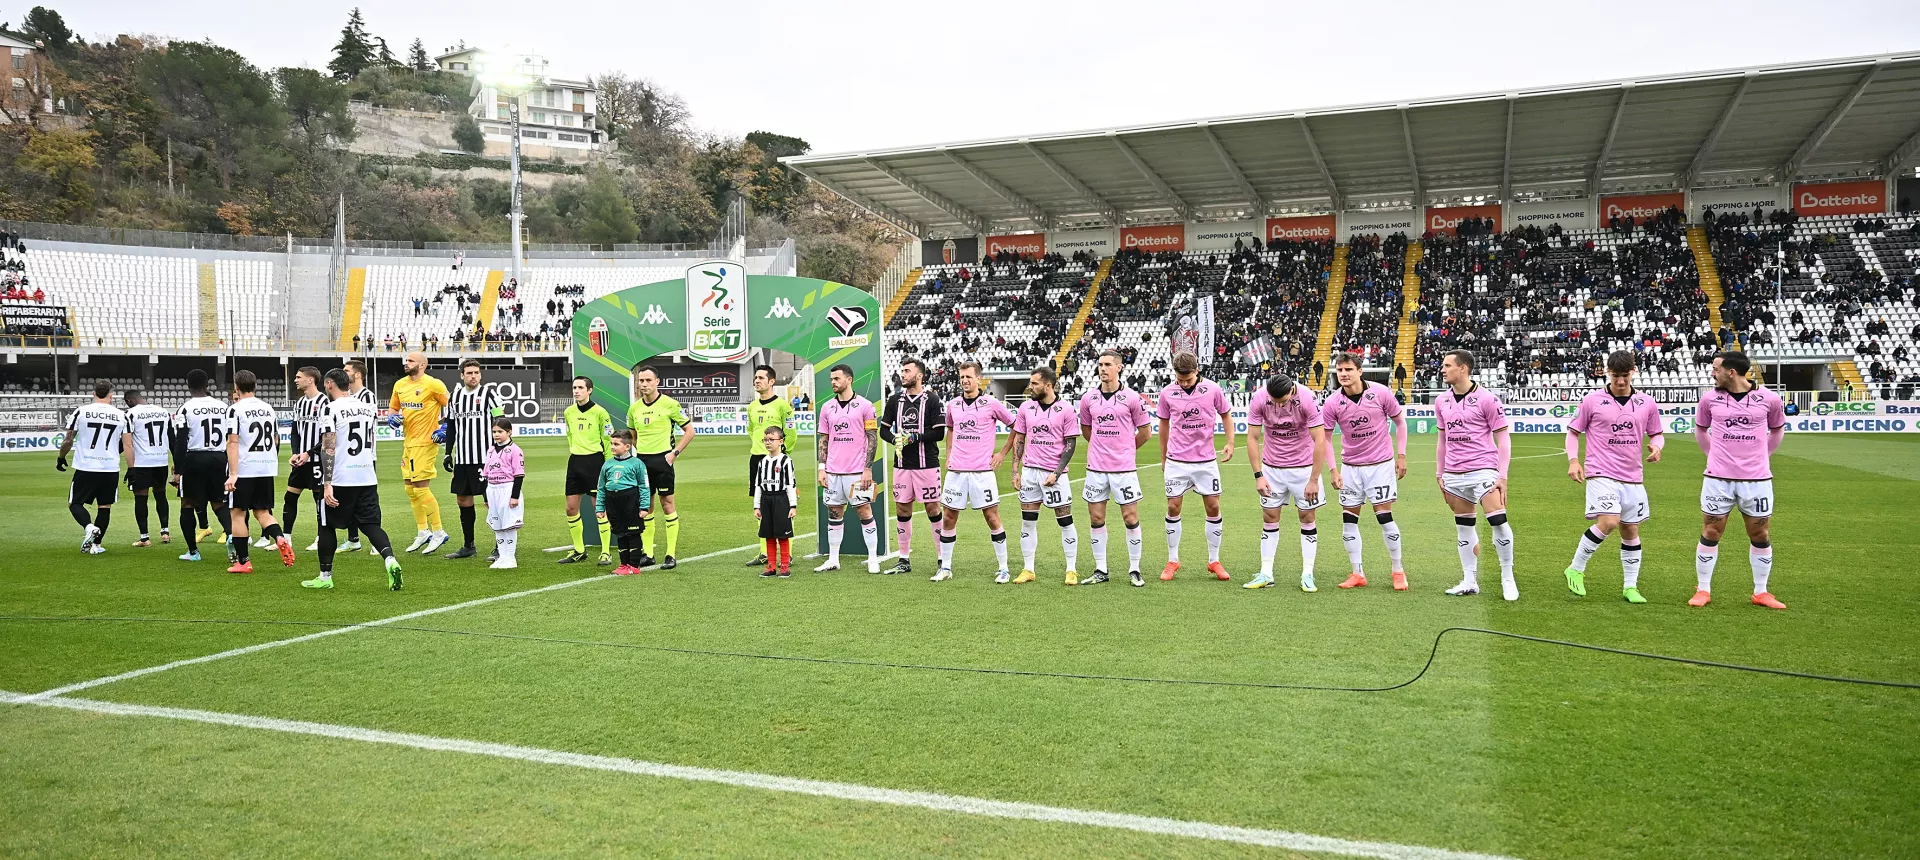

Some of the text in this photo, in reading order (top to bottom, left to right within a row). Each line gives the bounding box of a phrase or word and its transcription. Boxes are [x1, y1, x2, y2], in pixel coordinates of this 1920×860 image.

[1701, 202, 1743, 211] SHOPPING
[1751, 200, 1775, 208] MORE
[1800, 192, 1878, 208] Battente
[1517, 213, 1555, 221] SHOPPING
[1563, 211, 1585, 219] MORE
[1607, 204, 1672, 219] Battent
[1272, 224, 1330, 239] Battente
[1055, 241, 1083, 249] SHOPPING
[1125, 233, 1179, 247] Battente
[704, 316, 730, 326] Serie
[694, 329, 741, 349] BKT
[831, 338, 867, 346] PALERMO
[1508, 389, 1561, 401] PALLONARI
[1570, 389, 1596, 401] ASC
[1669, 389, 1698, 402] OFFIDA
[193, 407, 227, 415] GONDO
[245, 409, 271, 418] PROIA
[1504, 408, 1547, 416] CENO
[1670, 407, 1696, 415] del
[1834, 403, 1920, 414] BCC Ban
[85, 411, 120, 421] BUCHEL
[137, 412, 167, 420] ADJAPONG
[519, 427, 562, 435] Banca
[717, 425, 732, 433] del
[1514, 422, 1562, 432] Banca
[1798, 419, 1826, 431] del
[1832, 420, 1906, 431] PICENO
[87, 422, 118, 450] 77
[145, 421, 164, 447] 17
[201, 418, 222, 447] 15
[248, 420, 273, 452] 28
[347, 421, 372, 456] 54
[410, 459, 414, 471] 1
[313, 466, 322, 478] 5
[1213, 479, 1220, 491] 8
[922, 487, 937, 499] 22
[984, 489, 993, 502] 3
[1046, 490, 1061, 504] 30
[1120, 486, 1134, 500] 15
[1375, 485, 1390, 500] 37
[1638, 502, 1644, 517] 2
[1754, 497, 1769, 512] 10
